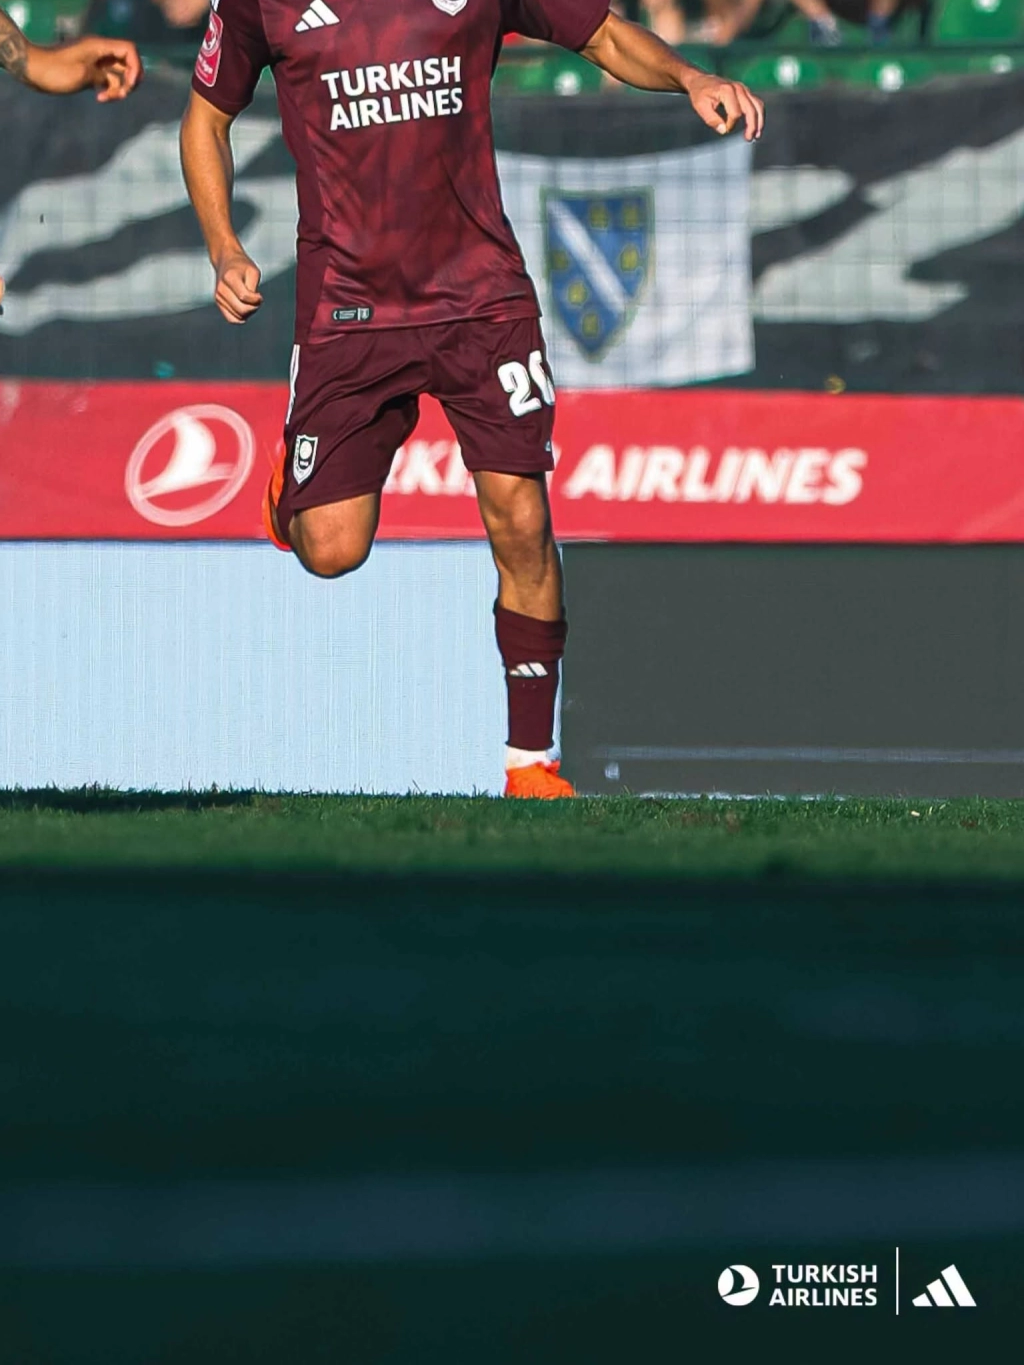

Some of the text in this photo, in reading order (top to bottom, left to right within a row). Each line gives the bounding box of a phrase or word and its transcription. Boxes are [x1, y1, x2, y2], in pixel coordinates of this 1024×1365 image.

[321, 56, 462, 100] TURKISH
[330, 87, 463, 131] AIRLINES
[563, 445, 868, 505] AIRLINES
